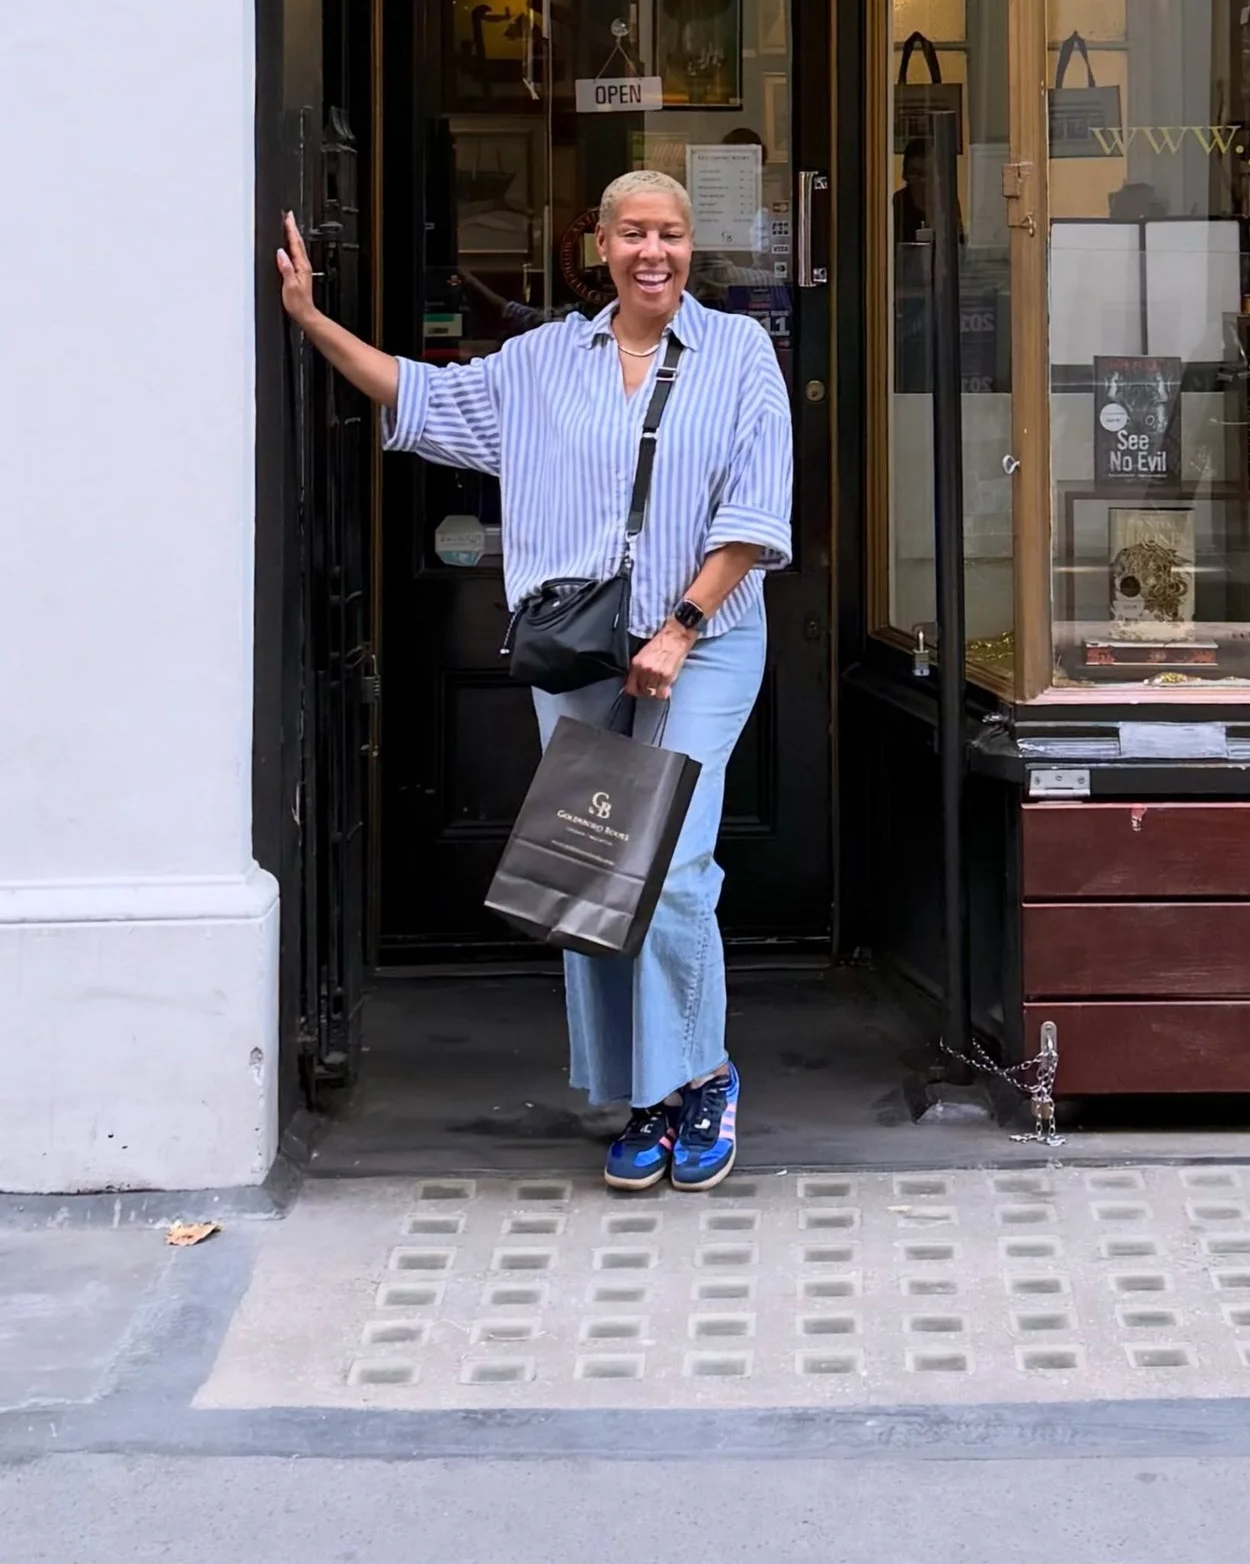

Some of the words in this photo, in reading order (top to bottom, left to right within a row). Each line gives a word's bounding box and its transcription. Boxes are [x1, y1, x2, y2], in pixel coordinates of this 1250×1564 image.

[595, 84, 642, 105] OPEN
[1116, 429, 1150, 451] See
[1109, 450, 1133, 472] No
[1137, 450, 1167, 472] Evil
